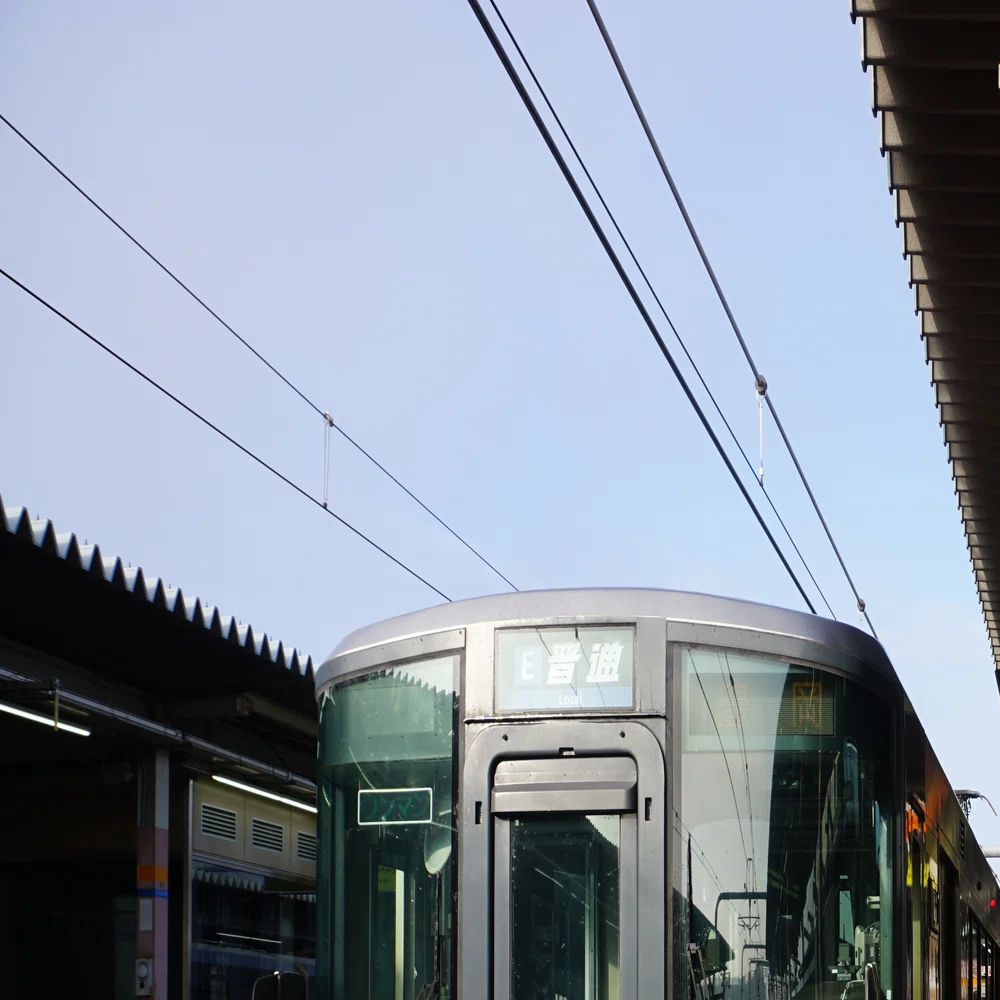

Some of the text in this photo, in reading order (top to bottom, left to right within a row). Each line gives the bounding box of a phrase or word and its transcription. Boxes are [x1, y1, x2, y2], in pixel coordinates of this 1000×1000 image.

[521, 640, 625, 684] E 普通
[559, 692, 582, 705] Local
